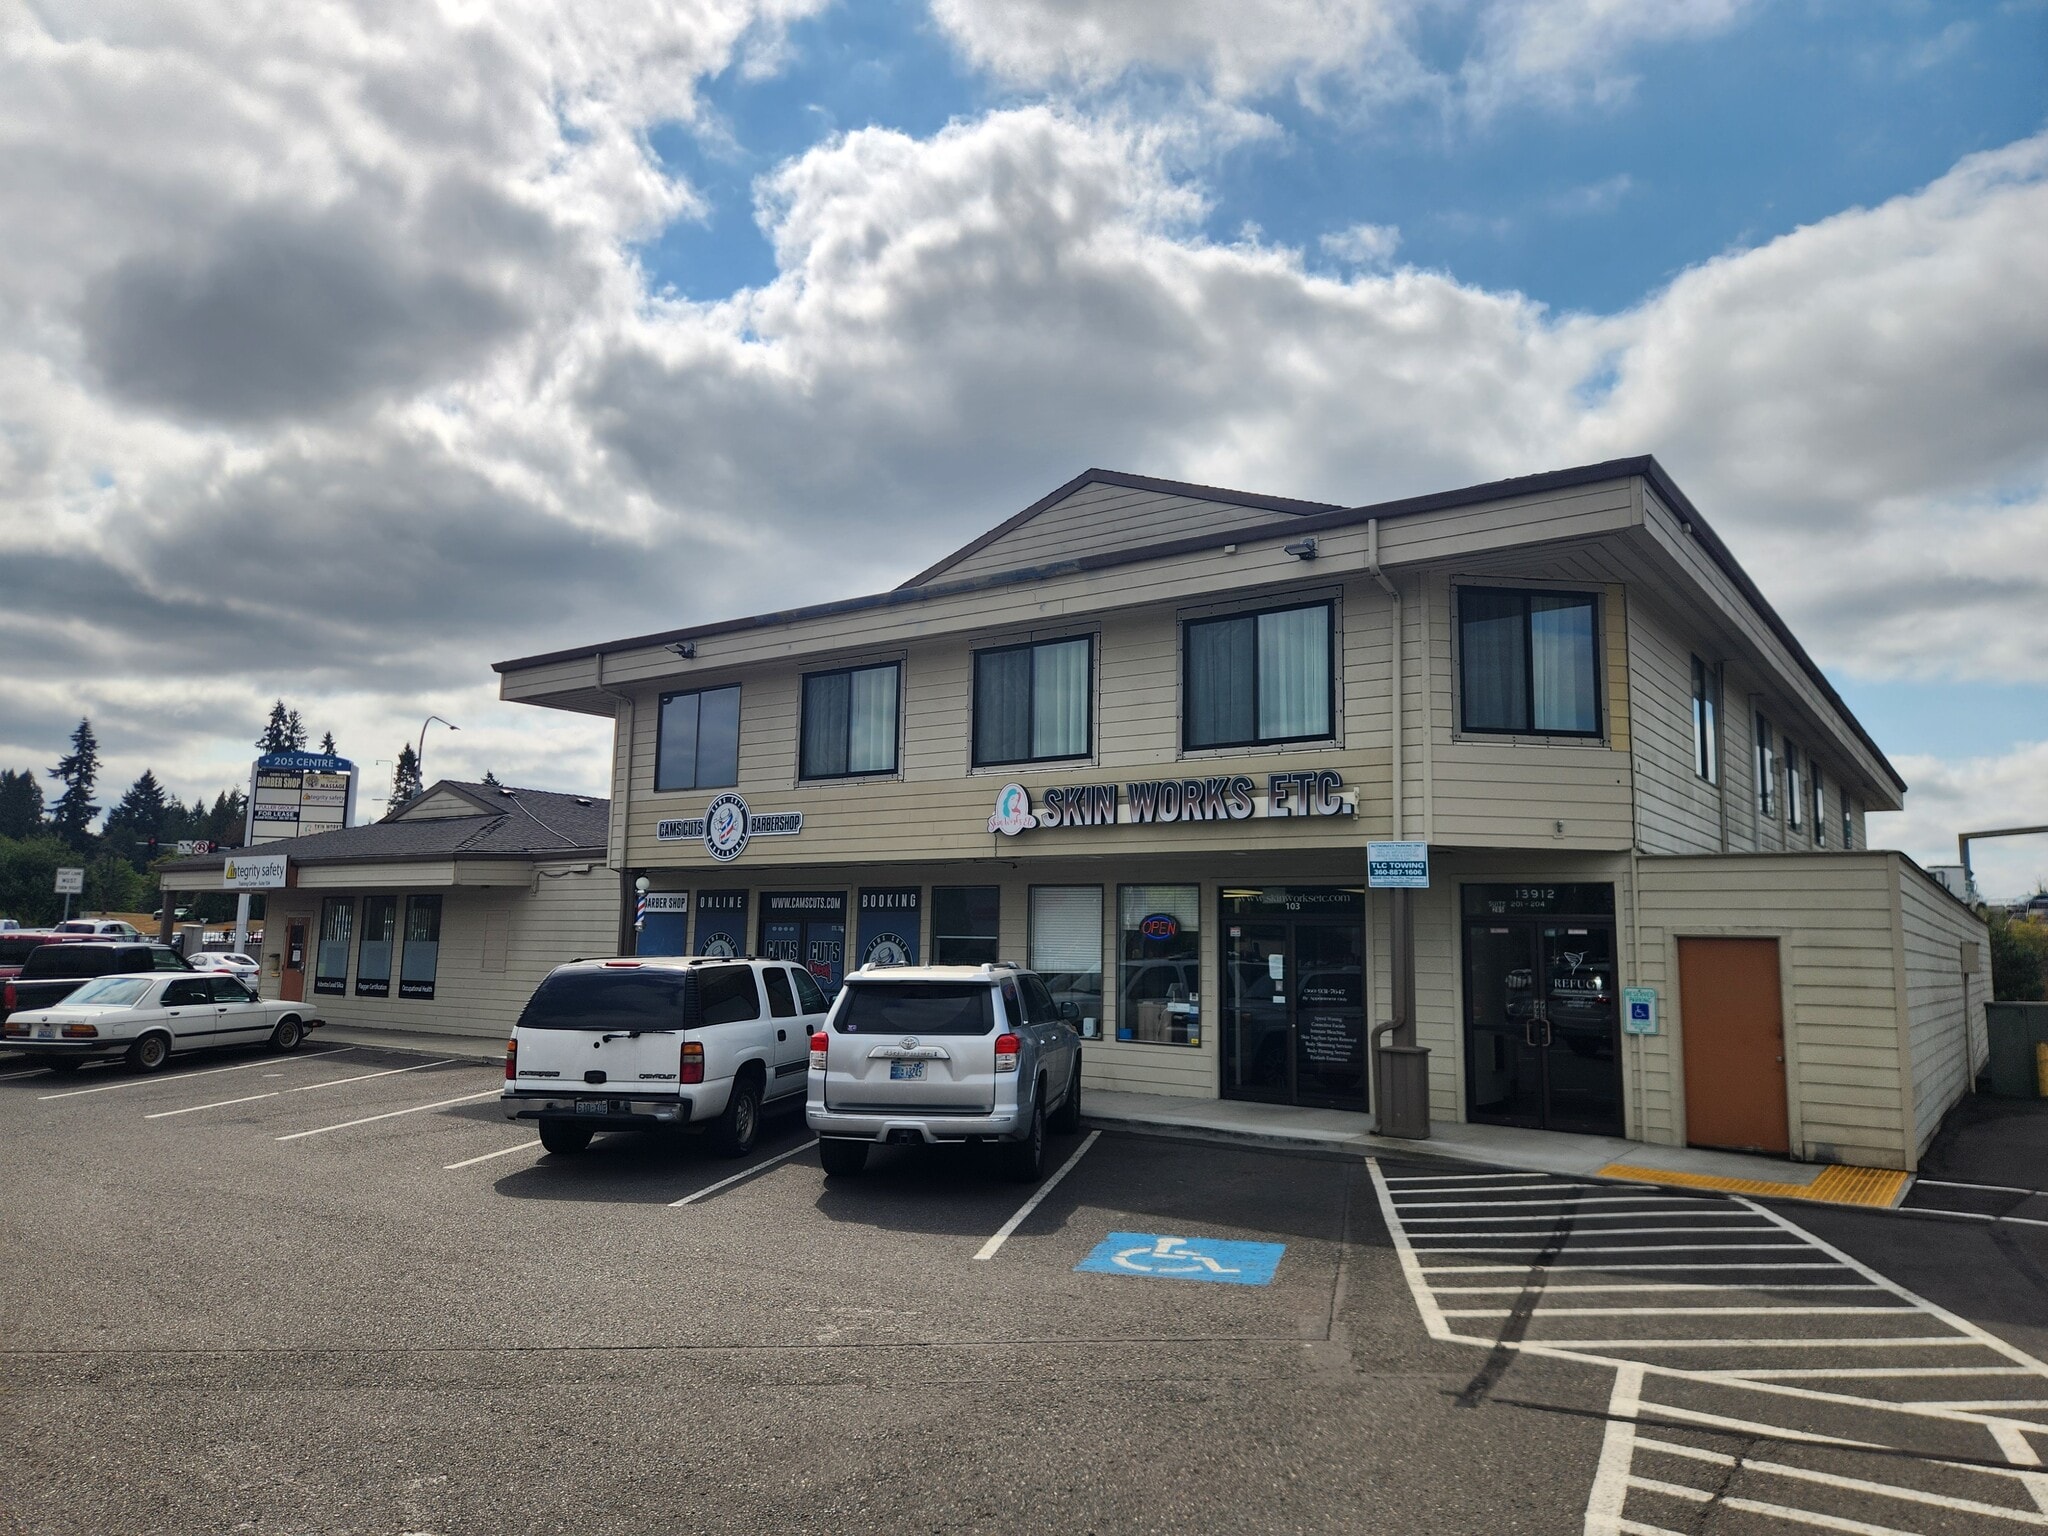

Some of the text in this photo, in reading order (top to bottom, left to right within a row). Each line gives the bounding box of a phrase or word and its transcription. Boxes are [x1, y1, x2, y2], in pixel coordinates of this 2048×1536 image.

[274, 758, 334, 767] 205 CENTRE
[257, 777, 301, 788] BARBER SHOP
[1041, 769, 1355, 828] SKIN WORKS ETC.
[660, 819, 703, 837] CAMS CUTS
[752, 815, 800, 832] BARBERSHOP
[262, 861, 285, 879] safety
[1238, 893, 1351, 903] www.skinworksetc.com
[1515, 889, 1555, 898] 13912
[669, 897, 686, 909] SHOP
[700, 896, 742, 908] ONLINE
[771, 897, 841, 909] WWW.CAMSCUTS.COM
[862, 893, 916, 908] BOOKING
[1285, 902, 1301, 910] 103
[1142, 920, 1176, 935] OPEN
[766, 940, 841, 962] CAMS CUTS
